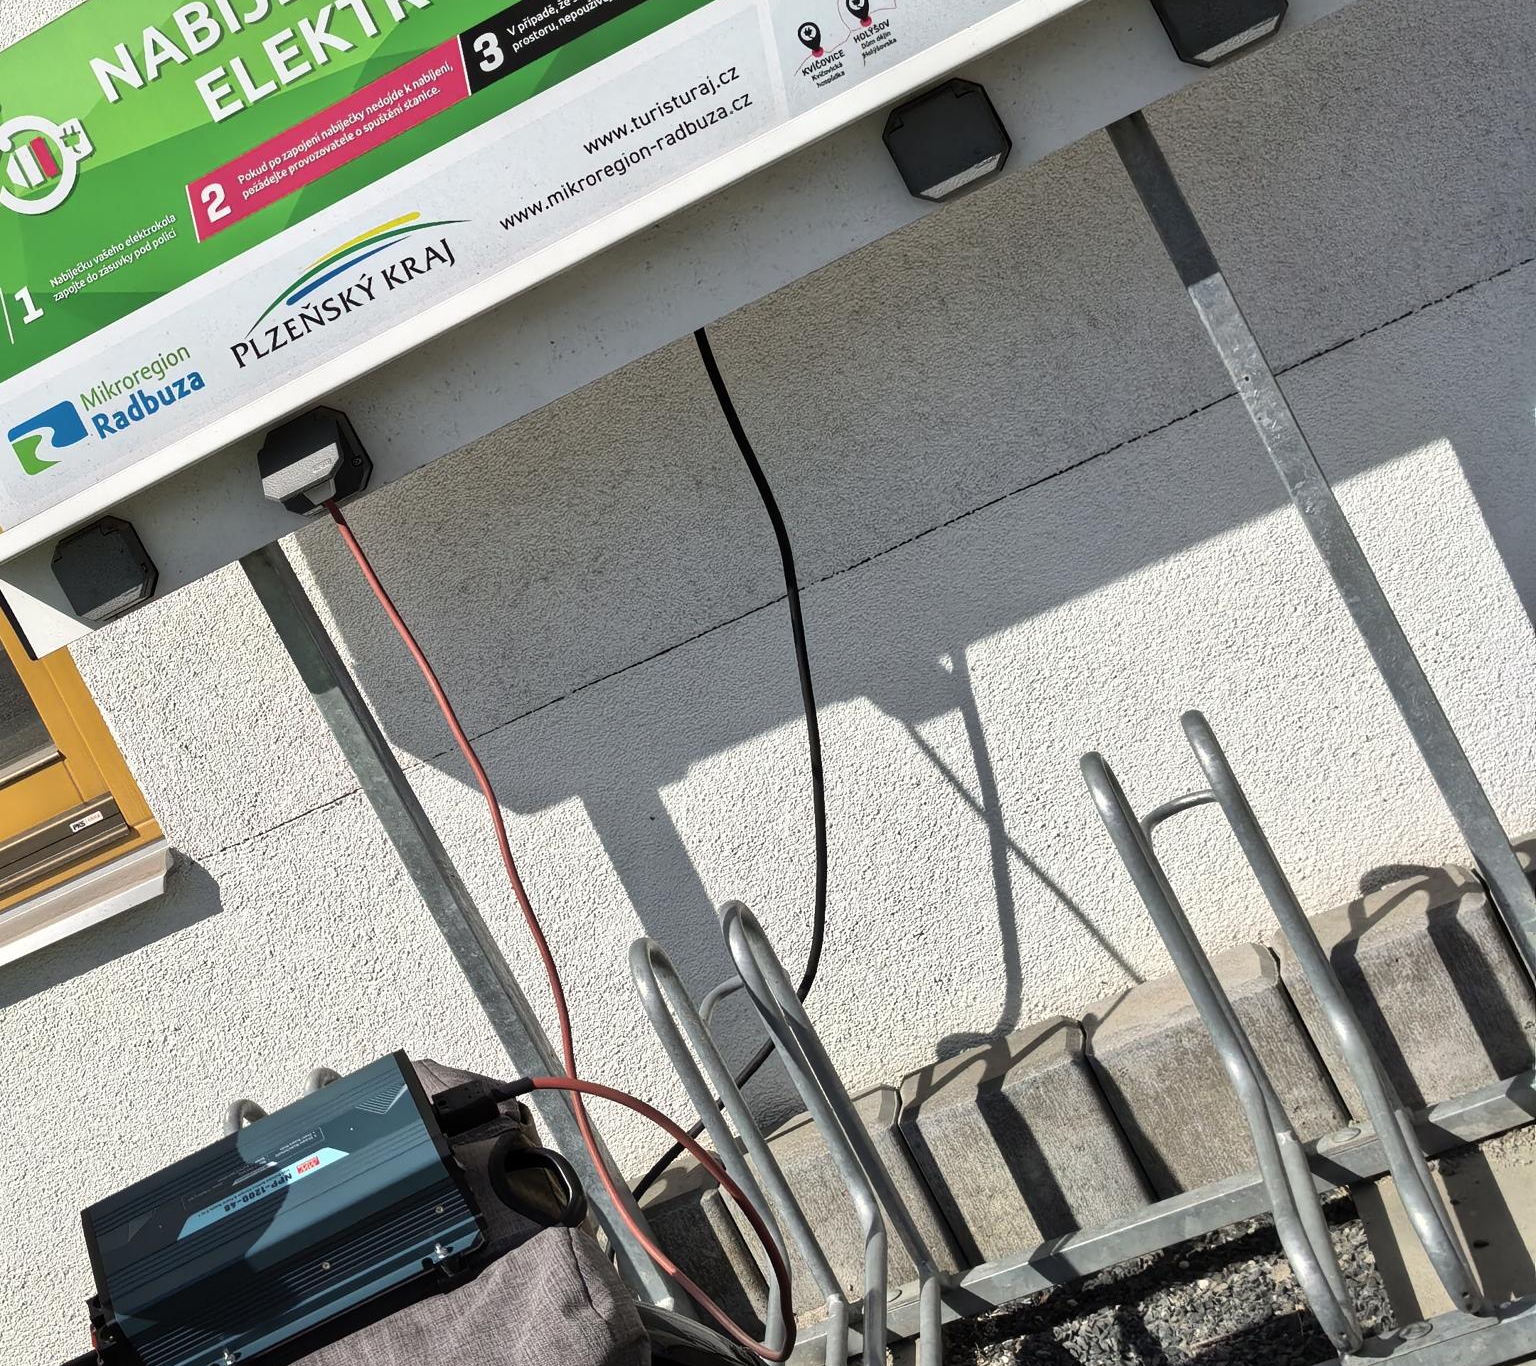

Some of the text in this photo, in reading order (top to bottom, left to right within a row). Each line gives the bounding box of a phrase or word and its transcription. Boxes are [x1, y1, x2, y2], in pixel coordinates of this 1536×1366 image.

[472, 31, 504, 72] 3
[506, 24, 515, 36] V
[516, 3, 559, 34] případě,
[511, 22, 559, 53] prostoru,
[852, 18, 889, 43] HOLÝŠOV
[801, 48, 845, 76] KVÍČOVICE
[236, 161, 268, 184] Pokud
[267, 156, 281, 170] po
[280, 132, 321, 161] zapojení
[320, 109, 364, 139] nabíječky
[365, 88, 404, 115] nedojde
[402, 83, 412, 93] k
[241, 86, 440, 200] požádejte provozovatele o spuštění stanice.
[582, 66, 739, 154] www.turisturaj.cz
[498, 92, 753, 230] www.mikroregion-radbuza.cz
[200, 182, 231, 223] 2
[49, 214, 176, 287] Nabíječku vašeho elektrokola
[52, 226, 176, 303] zapojte do zásuvky pod policí
[13, 284, 44, 324] 1
[229, 237, 455, 368] PLZEŇSKÝ KRAJ
[79, 346, 190, 415] Mikroregion
[90, 371, 205, 439] Radbuza
[224, 1173, 293, 1213] NPP-1200-48
